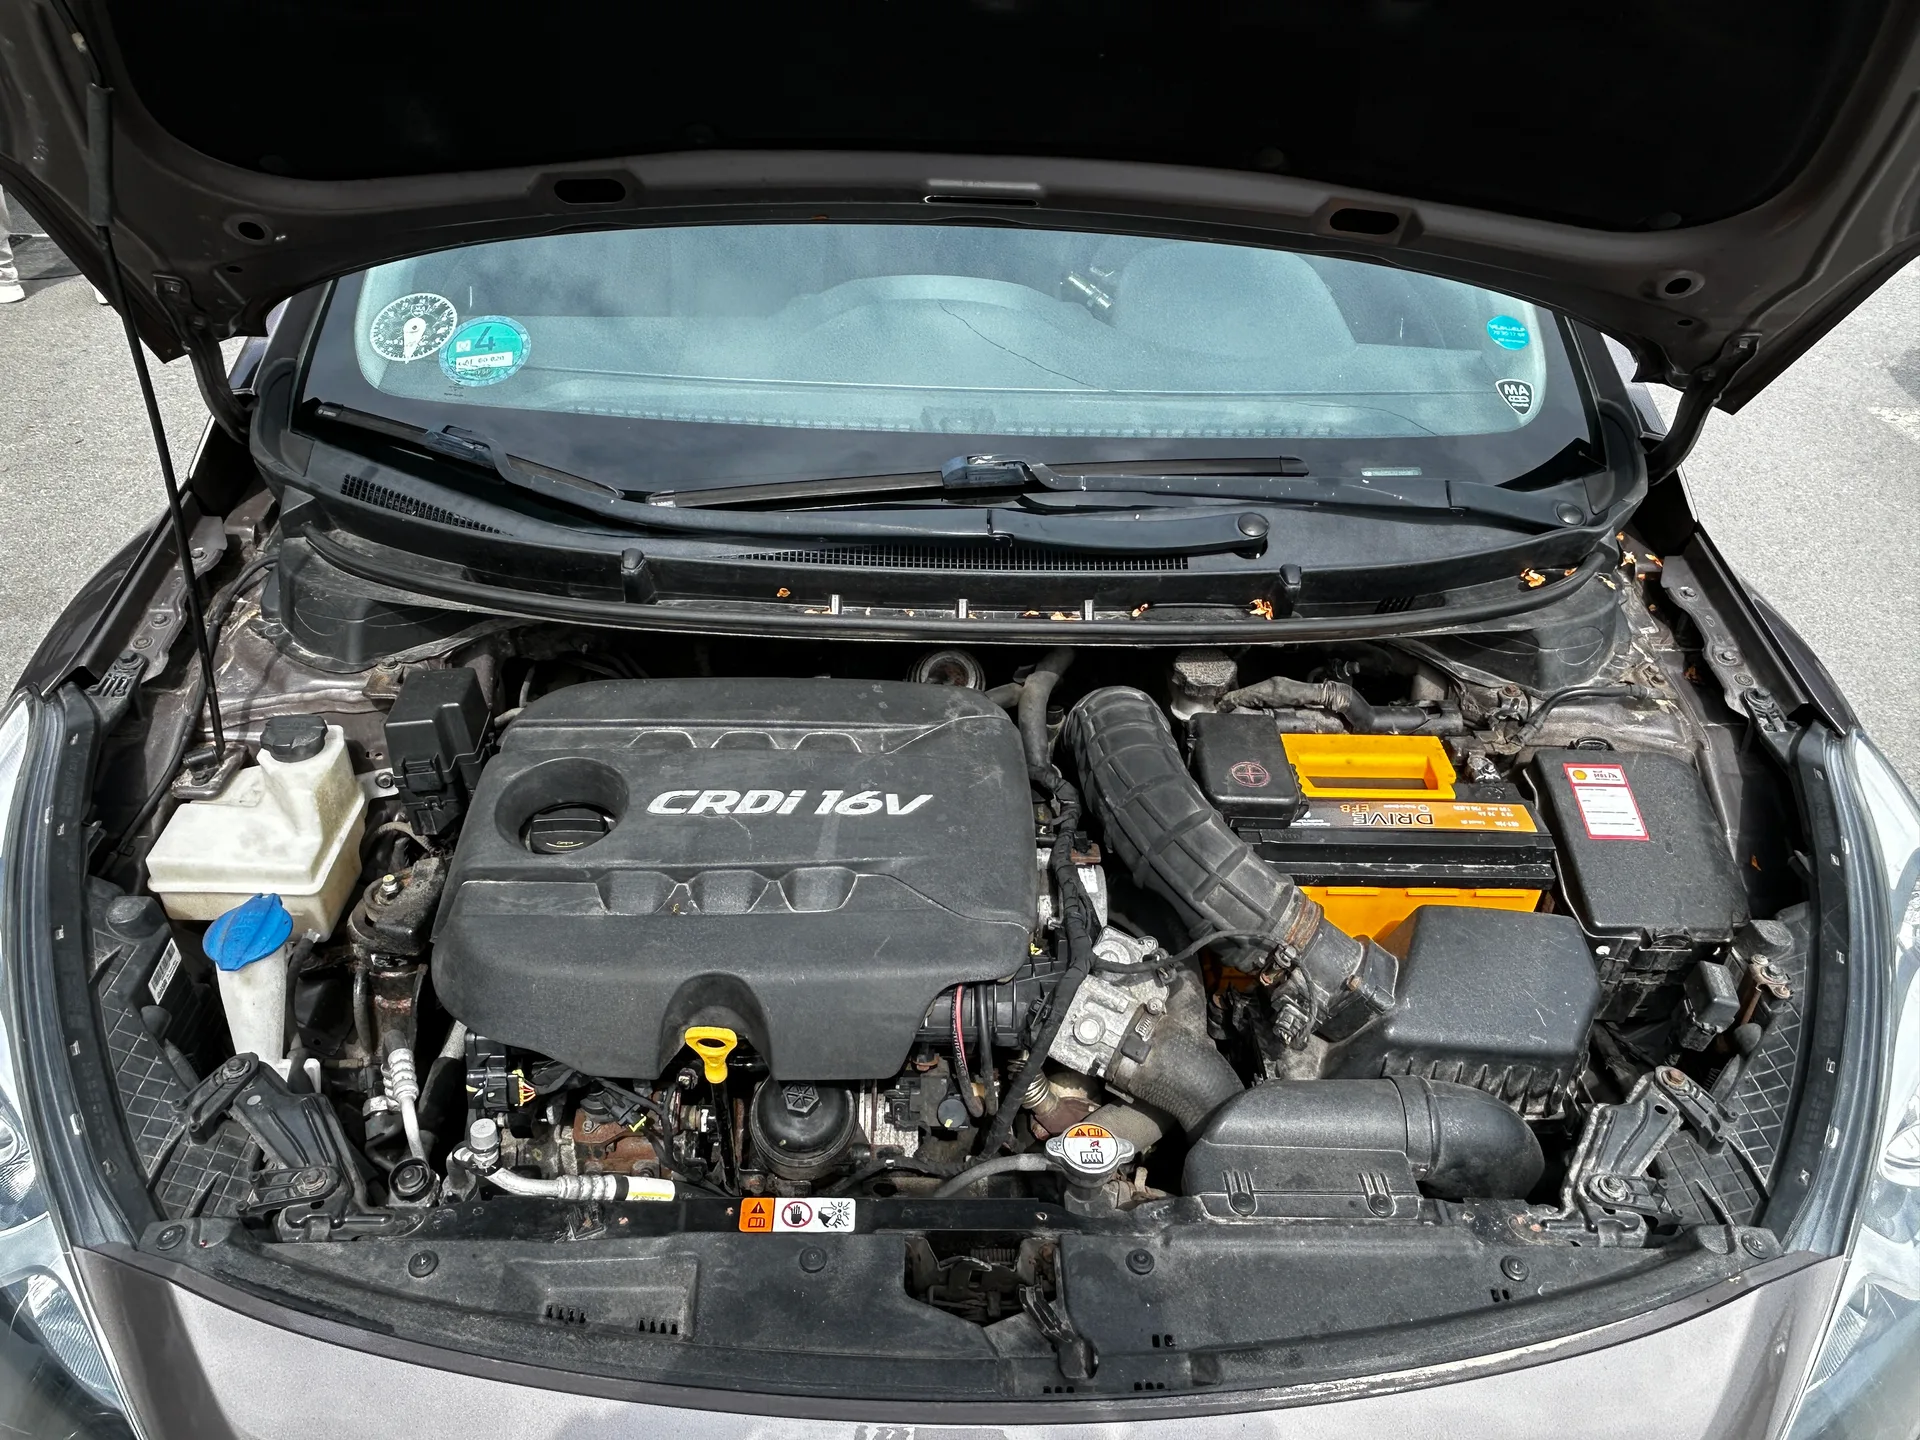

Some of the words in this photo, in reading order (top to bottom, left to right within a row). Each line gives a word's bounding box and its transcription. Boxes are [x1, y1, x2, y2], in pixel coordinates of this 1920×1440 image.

[474, 326, 496, 351] 4
[1504, 384, 1529, 395] MA
[646, 789, 806, 816] CRDi
[814, 789, 934, 816] 16V
[1340, 804, 1370, 813] EFB
[1352, 812, 1434, 826] DRIVE
